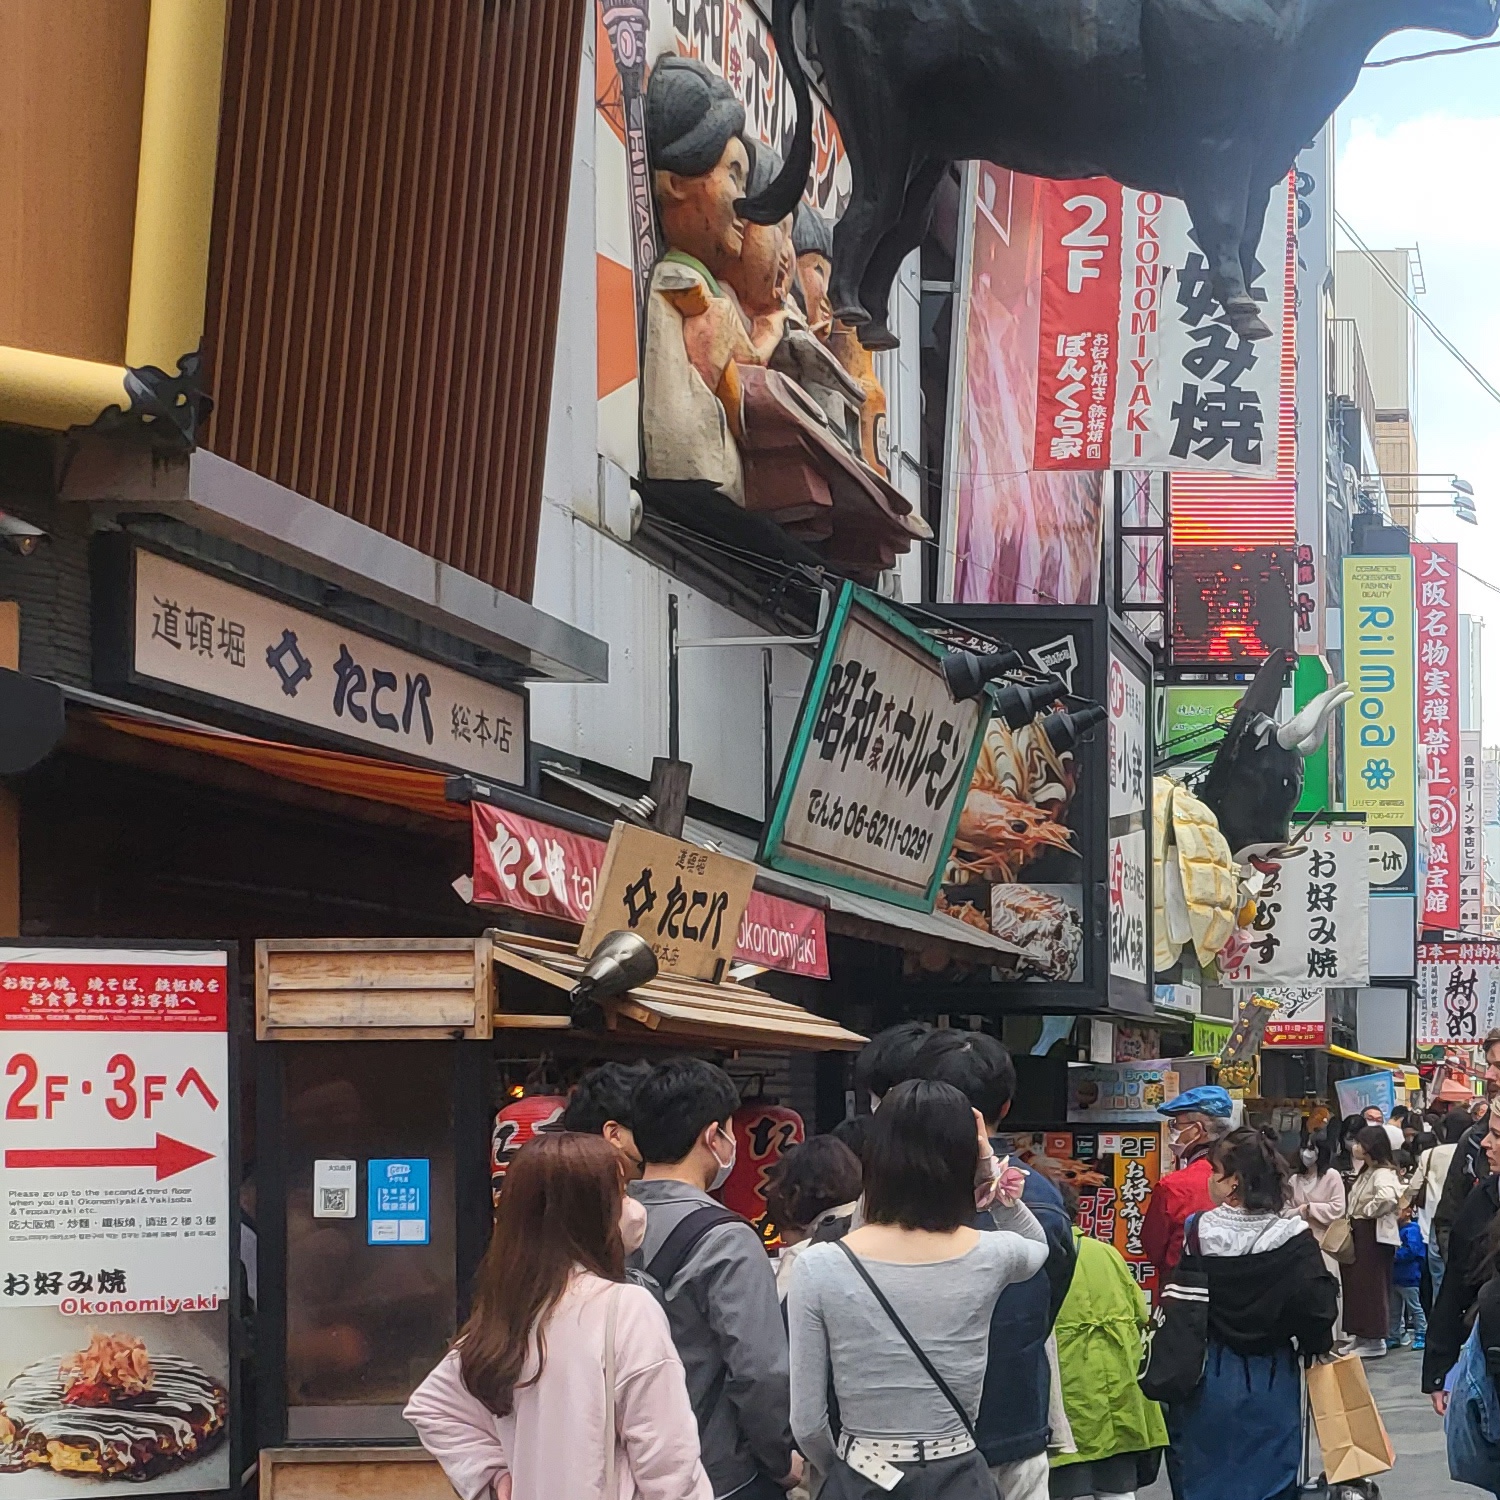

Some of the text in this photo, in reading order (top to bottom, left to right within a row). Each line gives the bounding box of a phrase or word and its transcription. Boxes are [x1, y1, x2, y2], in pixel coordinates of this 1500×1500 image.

[1061, 195, 1108, 293] 2F
[1127, 192, 1163, 457] OKONOMIYAKI
[151, 594, 247, 669] 道頓堀
[451, 701, 513, 754] 総本店
[812, 660, 883, 773] 昭和
[884, 695, 969, 812] ホルモン
[1420, 552, 1452, 913] 大阪名物実弾禁止 秘宝館
[844, 801, 932, 864] 06-6211-0291
[1306, 849, 1338, 979] お好み焼
[1121, 1137, 1156, 1157] 2F
[3, 1269, 127, 1296] お好み焼
[60, 1293, 218, 1314] Okonomiyaki
